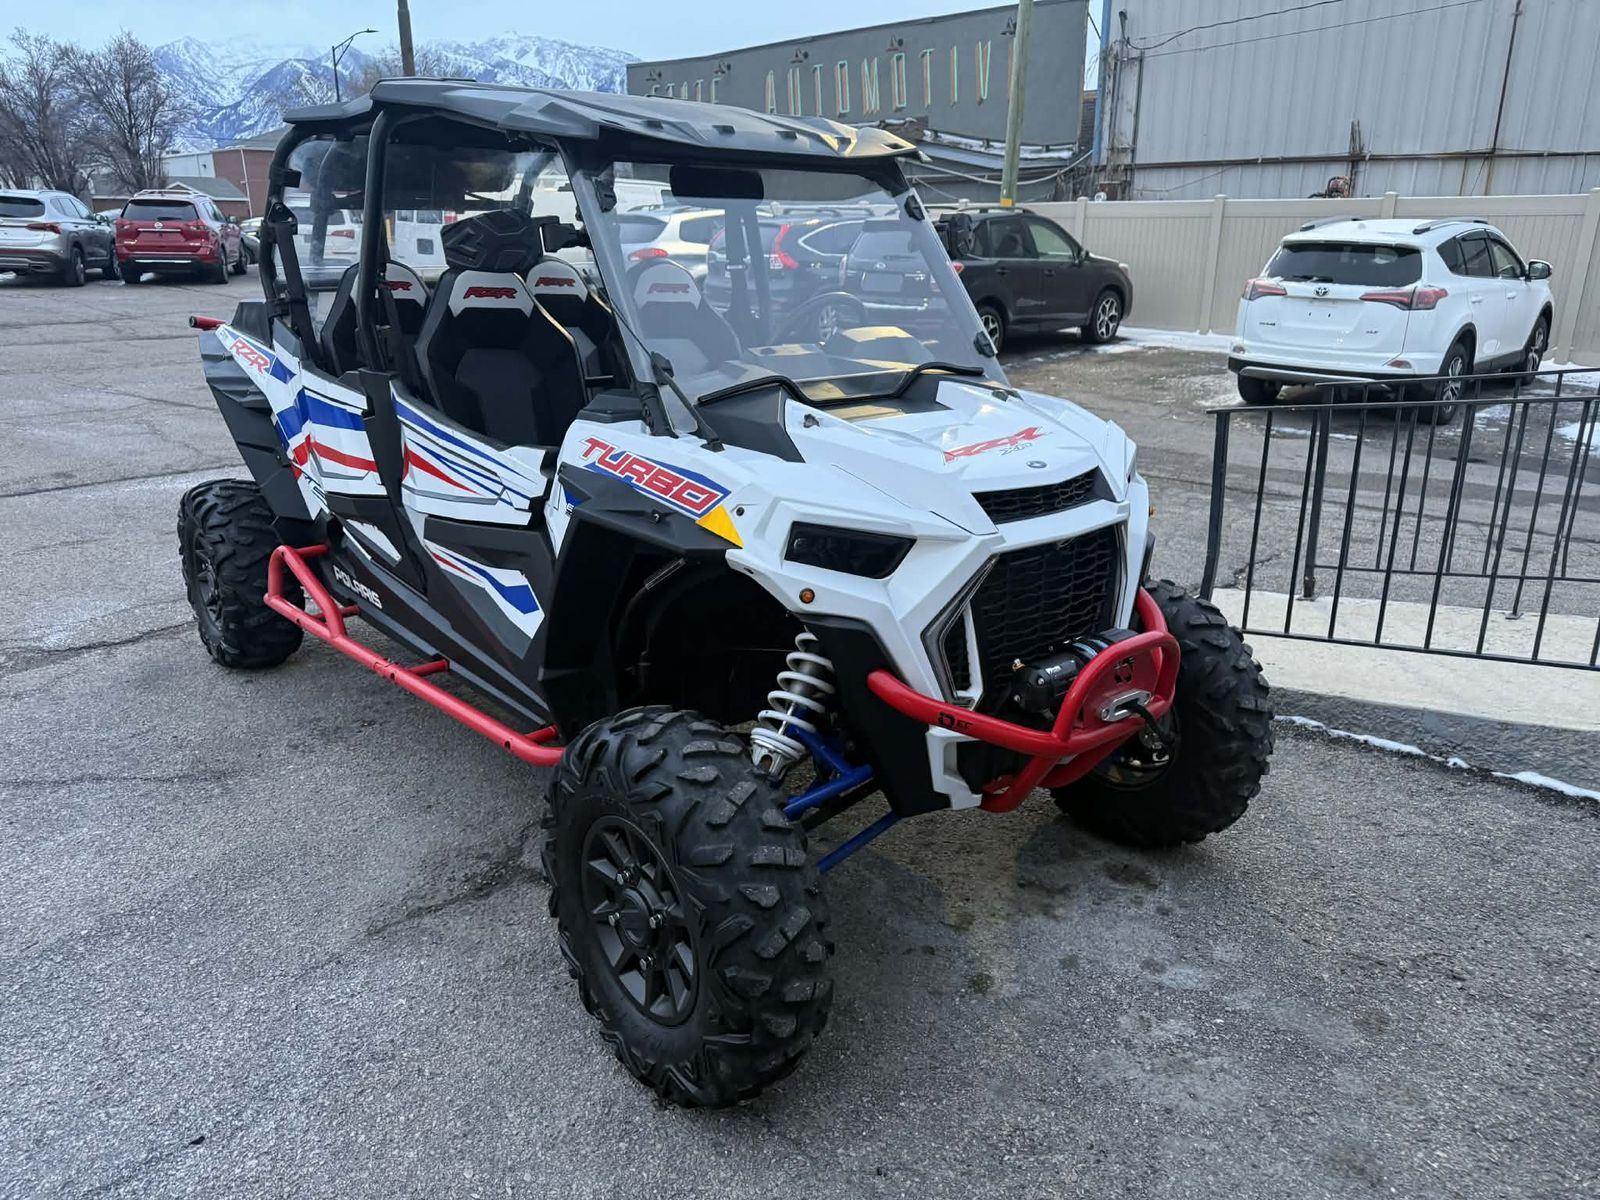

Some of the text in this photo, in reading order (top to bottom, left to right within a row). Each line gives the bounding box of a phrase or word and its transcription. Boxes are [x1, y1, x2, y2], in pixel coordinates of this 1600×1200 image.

[765, 38, 1014, 117] AUTOMOTIV
[463, 286, 518, 299] RZR
[228, 337, 271, 375] RZR
[580, 436, 721, 514] TURBO
[332, 565, 383, 610] POLARIS
